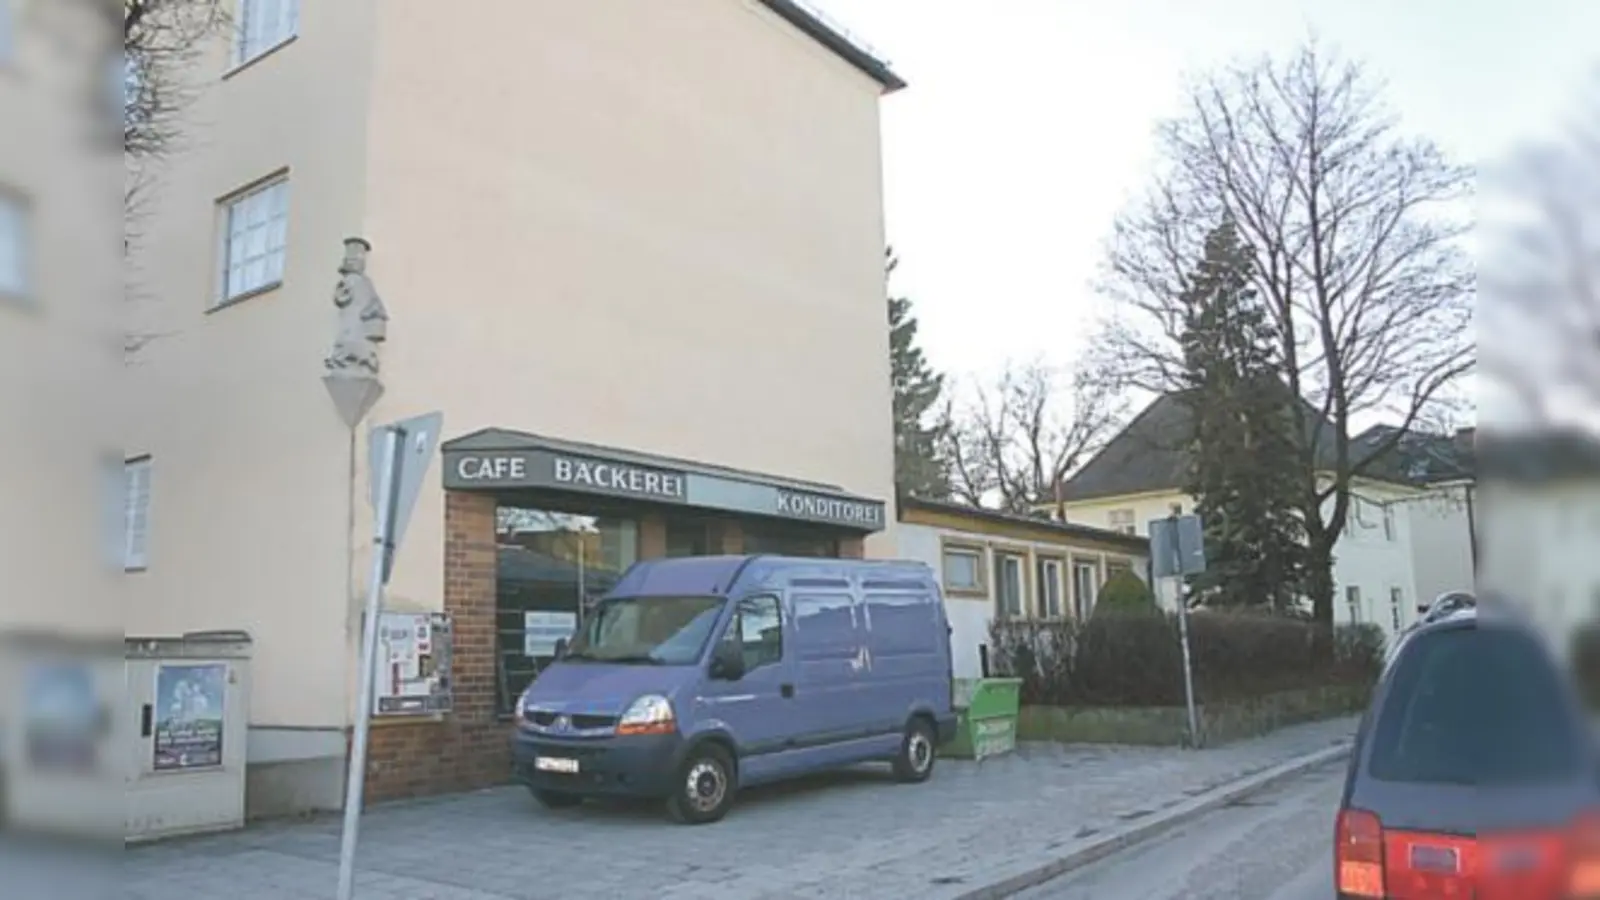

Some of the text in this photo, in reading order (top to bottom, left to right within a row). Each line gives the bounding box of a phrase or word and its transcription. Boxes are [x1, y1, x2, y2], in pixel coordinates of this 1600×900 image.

[457, 456, 880, 524] CAFE BÄCKEREI KONDITOREI
